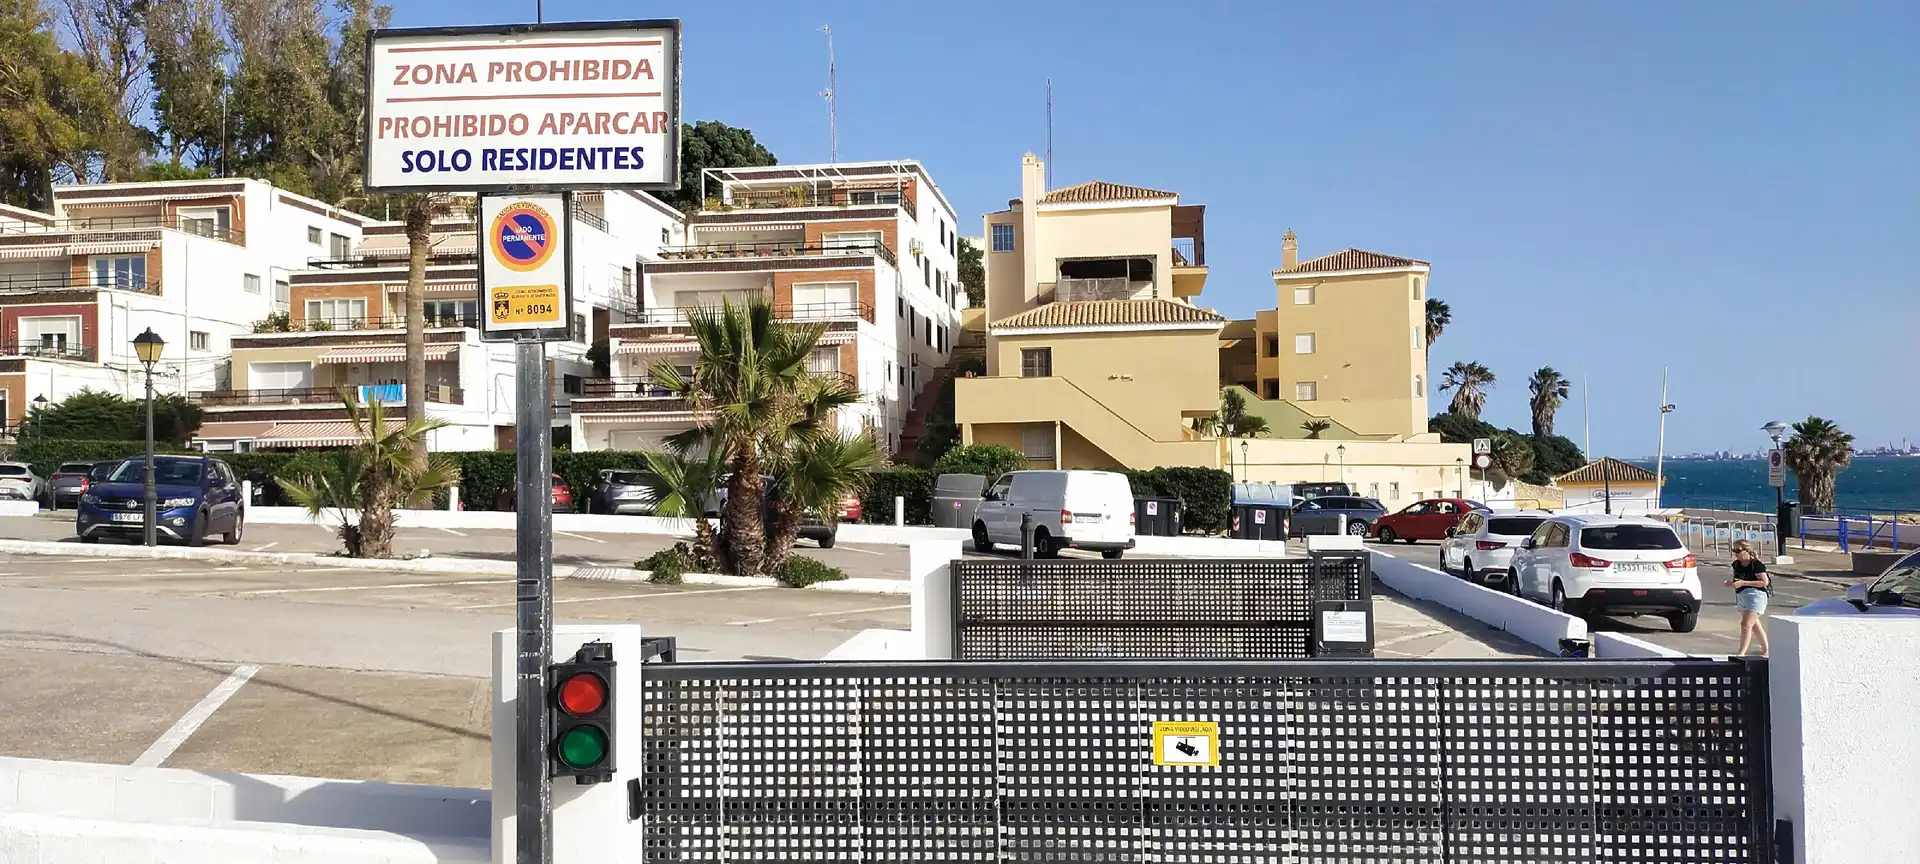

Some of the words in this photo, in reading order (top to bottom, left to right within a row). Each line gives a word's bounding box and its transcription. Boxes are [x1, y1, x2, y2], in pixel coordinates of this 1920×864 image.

[393, 62, 478, 86] ZONA
[487, 58, 655, 83] PROHIBIDA
[378, 113, 529, 139] PROHIBIDO
[537, 111, 669, 136] APARCAR
[401, 149, 472, 173] SOLO
[481, 146, 645, 172] RESIDENTES
[503, 234, 546, 242] PERMANENTE
[527, 304, 553, 314] 8094
